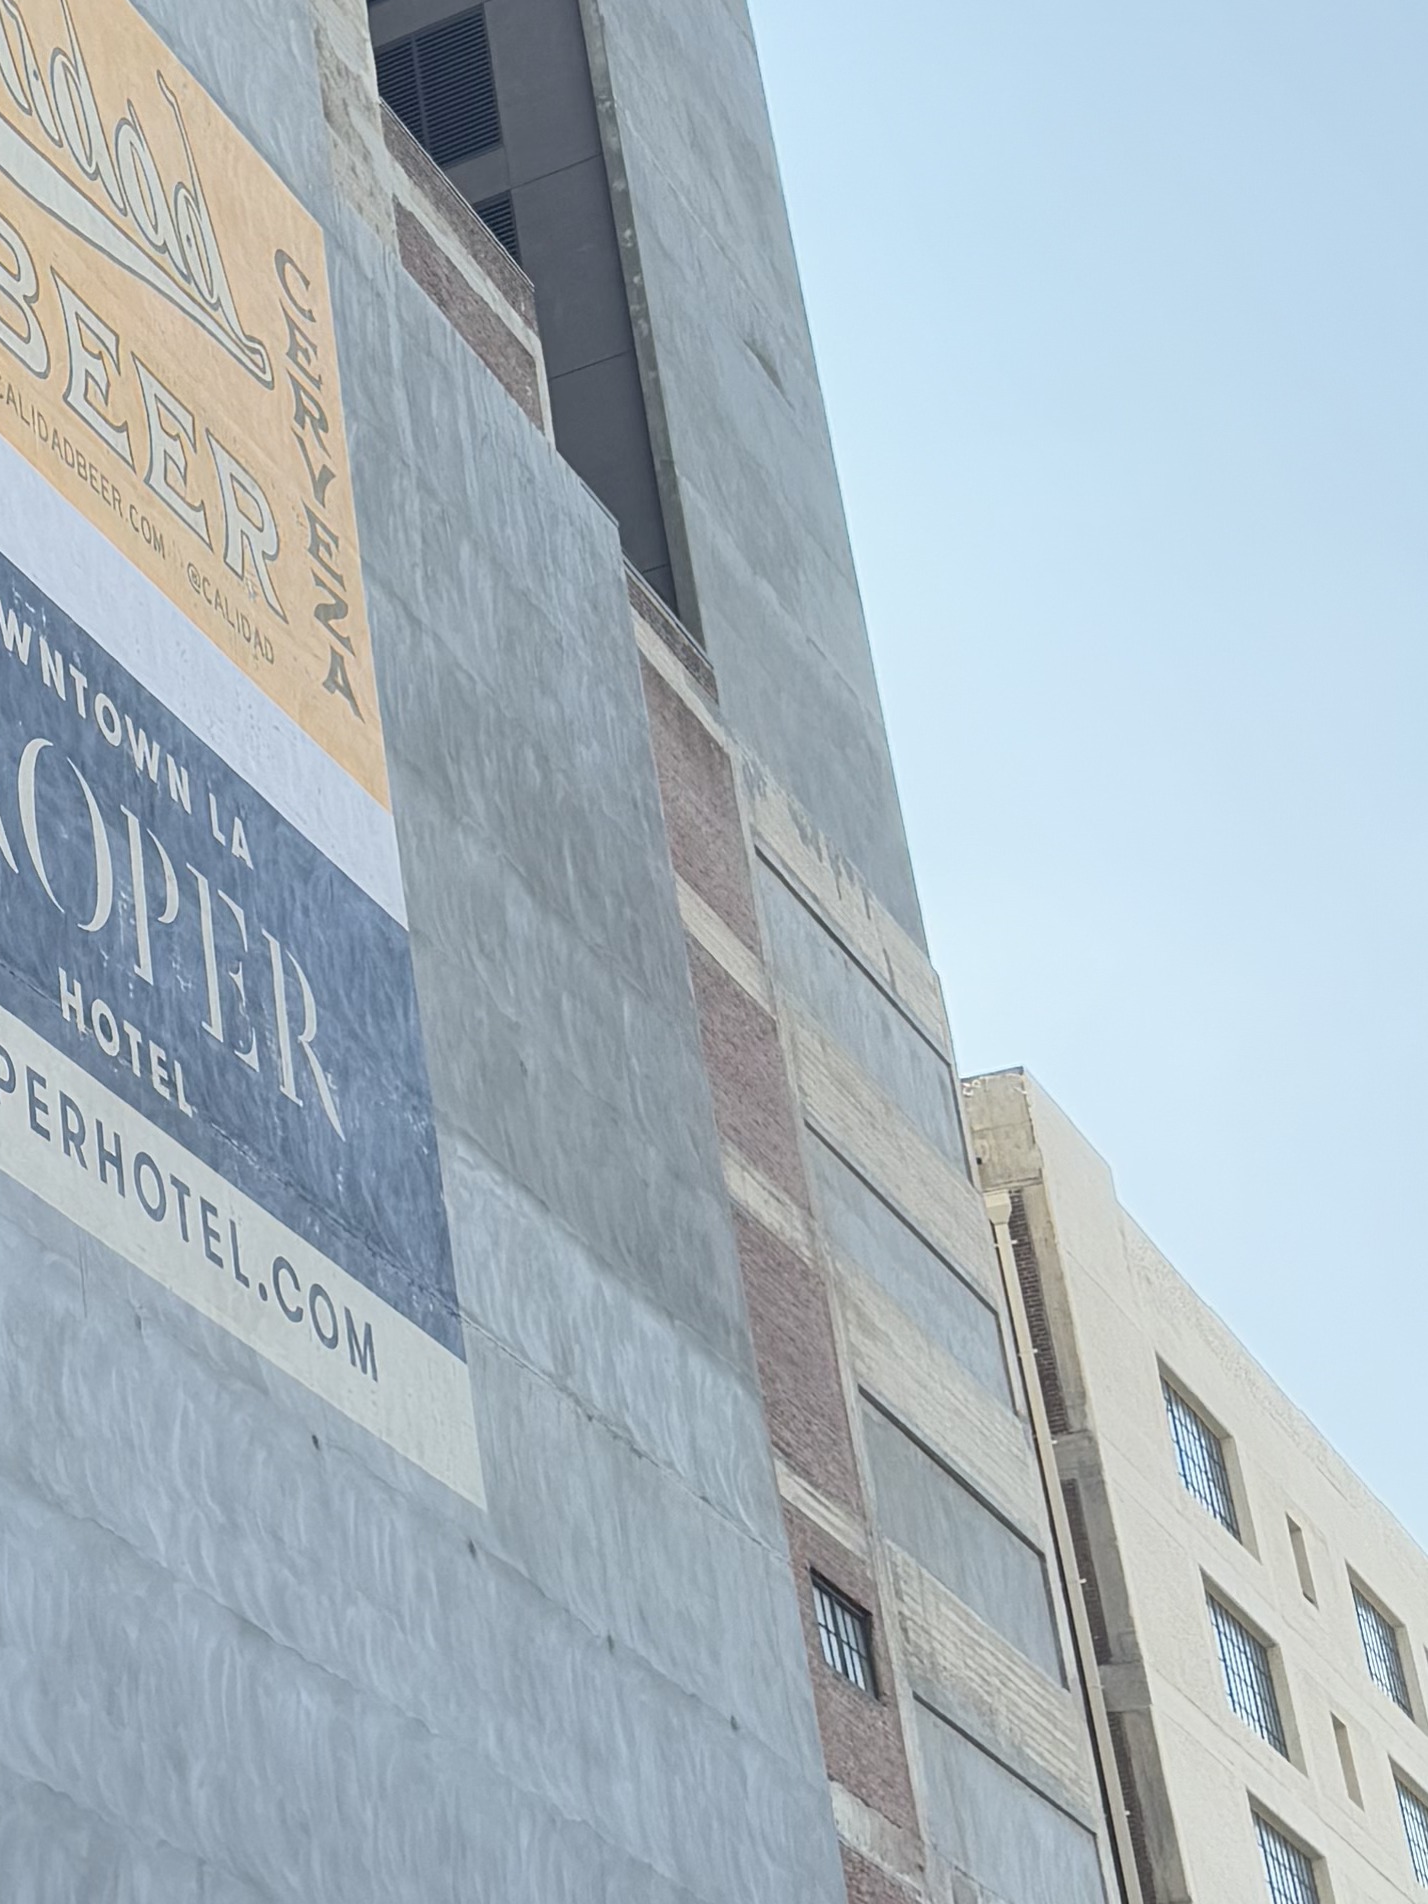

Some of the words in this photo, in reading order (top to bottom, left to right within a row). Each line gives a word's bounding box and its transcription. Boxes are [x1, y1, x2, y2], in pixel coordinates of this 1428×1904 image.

[274, 248, 366, 724] CERVEZA
[187, 562, 275, 665] @CALIDAD
[210, 790, 254, 871] LA
[58, 967, 194, 1118] HOTEL
